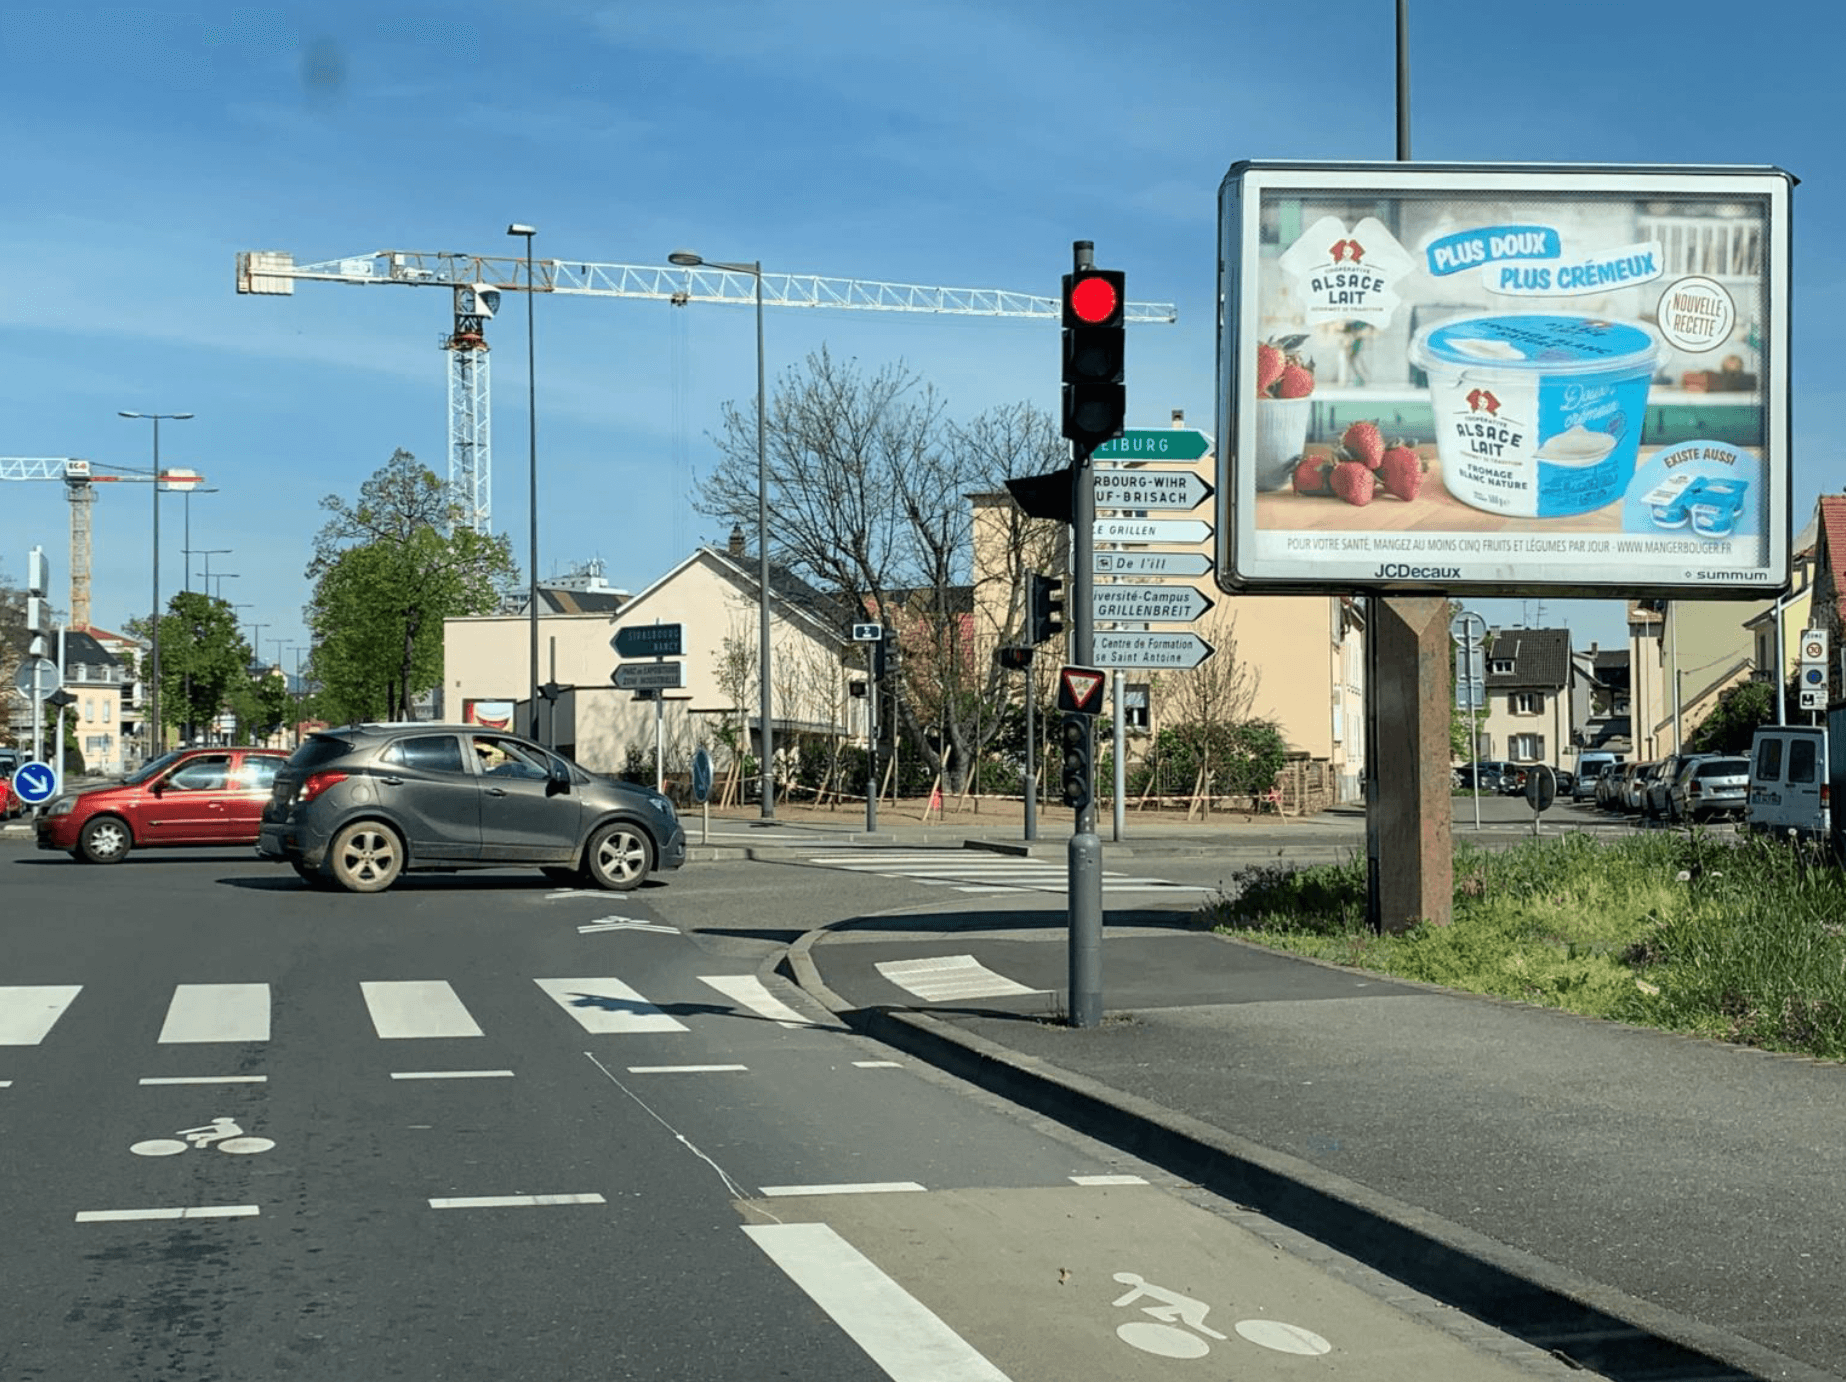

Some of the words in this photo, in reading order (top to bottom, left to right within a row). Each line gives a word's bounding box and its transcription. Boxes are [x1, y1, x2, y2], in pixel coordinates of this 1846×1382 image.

[1433, 239, 1485, 270] PLUS
[1489, 232, 1546, 258] DOUX
[1500, 267, 1551, 290] PLUS
[1557, 251, 1657, 289] CRÉMEUX
[1310, 273, 1385, 293] ALSACE
[1329, 290, 1366, 305] LAIT
[1672, 292, 1723, 318] NOUVELLE
[1673, 313, 1716, 337] RECETTE
[1456, 422, 1523, 448] ALSACE
[1101, 437, 1169, 453] EIBURG
[1470, 438, 1504, 457] LAIT
[1664, 448, 1700, 469] EXISTE
[1703, 448, 1737, 466] AUSSI
[1094, 476, 1187, 489] RBOURG-WIHR
[1487, 477, 1528, 490] NATURE
[1096, 491, 1187, 504] UF-BRISACH
[1109, 525, 1156, 536] GRILLEN
[1287, 538, 1311, 551] POUR
[1313, 538, 1340, 551] VOTRE
[1373, 538, 1412, 551] MANGEZ
[1413, 539, 1425, 551] AU
[1427, 539, 1457, 551] MOINS
[1458, 539, 1481, 553] CINQ
[1482, 540, 1512, 552] FRUITS
[1513, 540, 1523, 552] ET
[1525, 537, 1566, 552] LÉGUMES
[1568, 540, 1586, 552] PAR
[1587, 541, 1610, 553] JOUR
[1617, 541, 1732, 555] WWW.MANGERBOUGER.FR
[1116, 557, 1134, 569] De
[1374, 564, 1461, 579] JCDecaux
[1697, 571, 1768, 581] summum
[1094, 590, 1190, 605] iversité-Campus
[1098, 604, 1192, 617] GRILLENBREIT
[1101, 637, 1132, 649] Centre
[1133, 637, 1146, 649] de
[1147, 637, 1193, 650] Formation
[1095, 652, 1107, 662] se
[1110, 651, 1138, 663] Saint
[1143, 651, 1182, 663] Antoine
